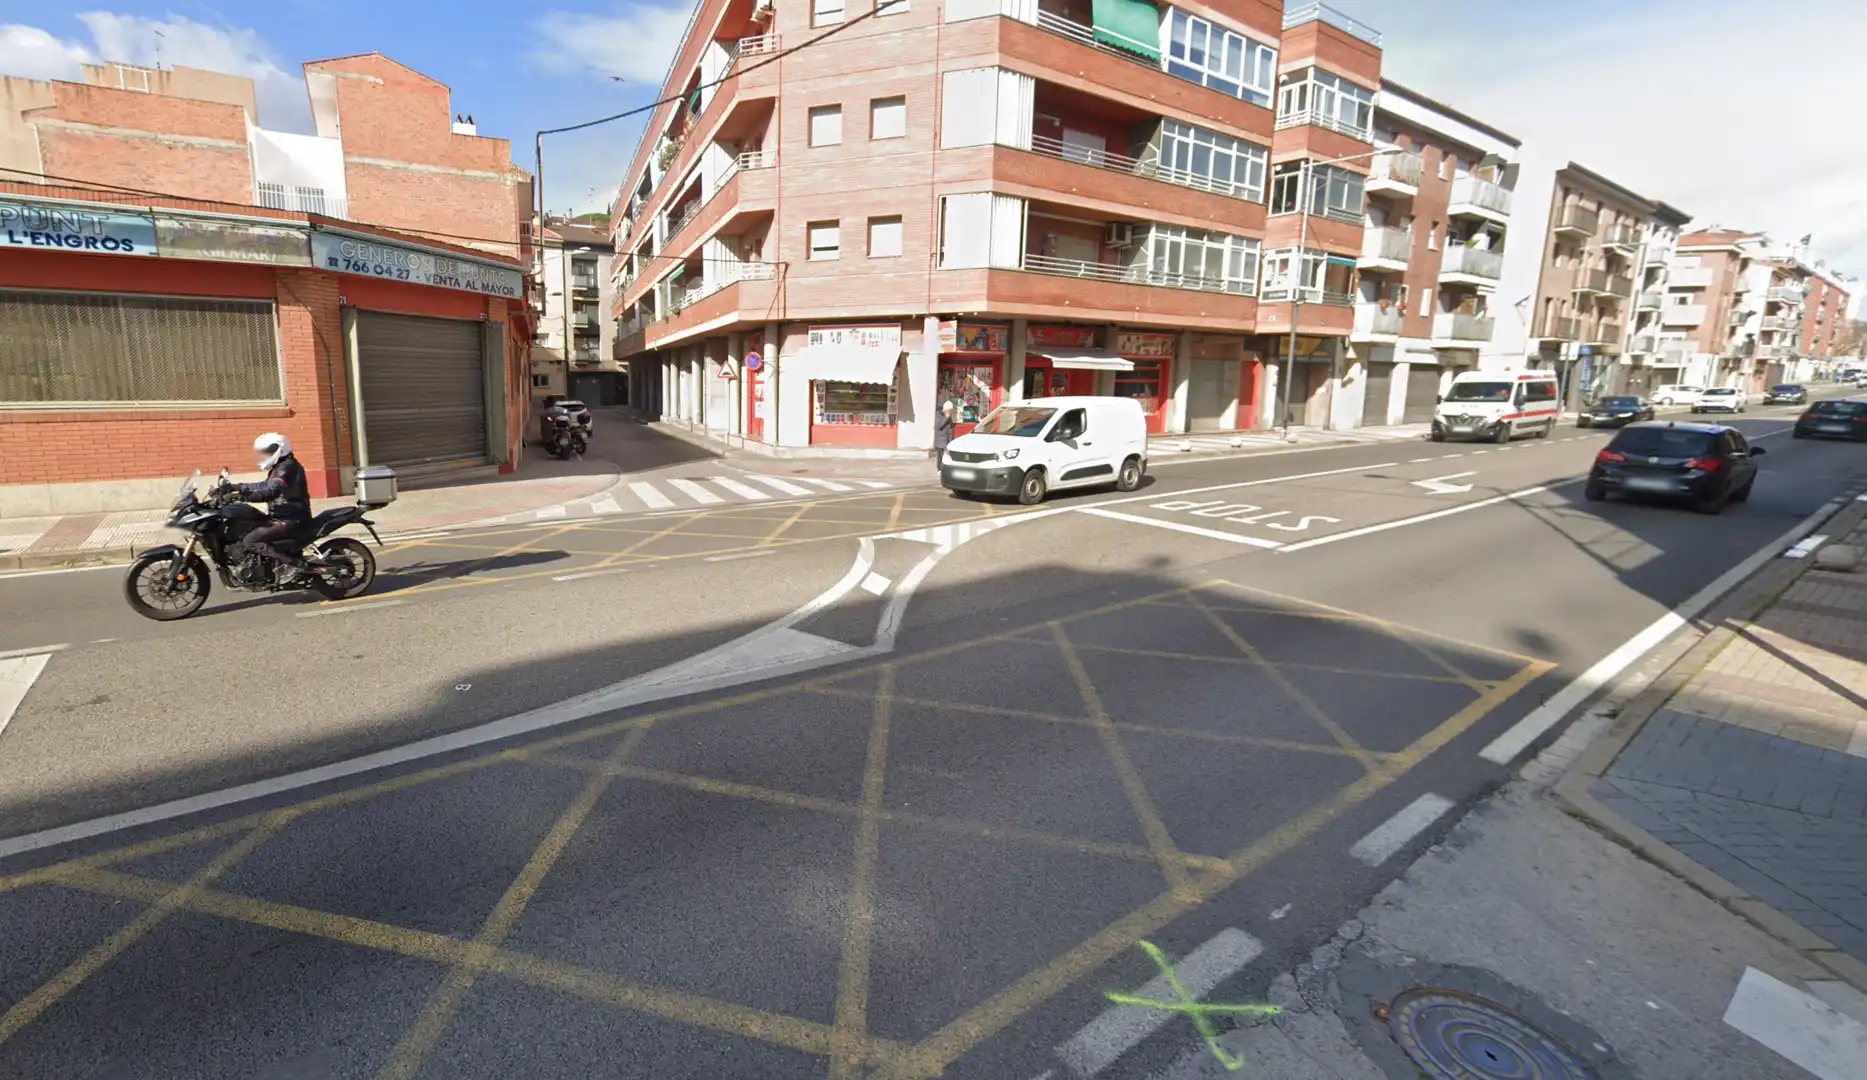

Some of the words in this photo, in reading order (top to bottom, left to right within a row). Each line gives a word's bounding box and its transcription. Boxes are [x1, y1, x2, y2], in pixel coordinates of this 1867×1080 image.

[343, 258, 370, 274] 766
[373, 264, 393, 277] 04
[396, 267, 410, 280] 27
[424, 273, 461, 288] VENTA
[465, 279, 478, 291] AL
[481, 281, 515, 297] MAYOR
[1149, 500, 1342, 532] STOP
